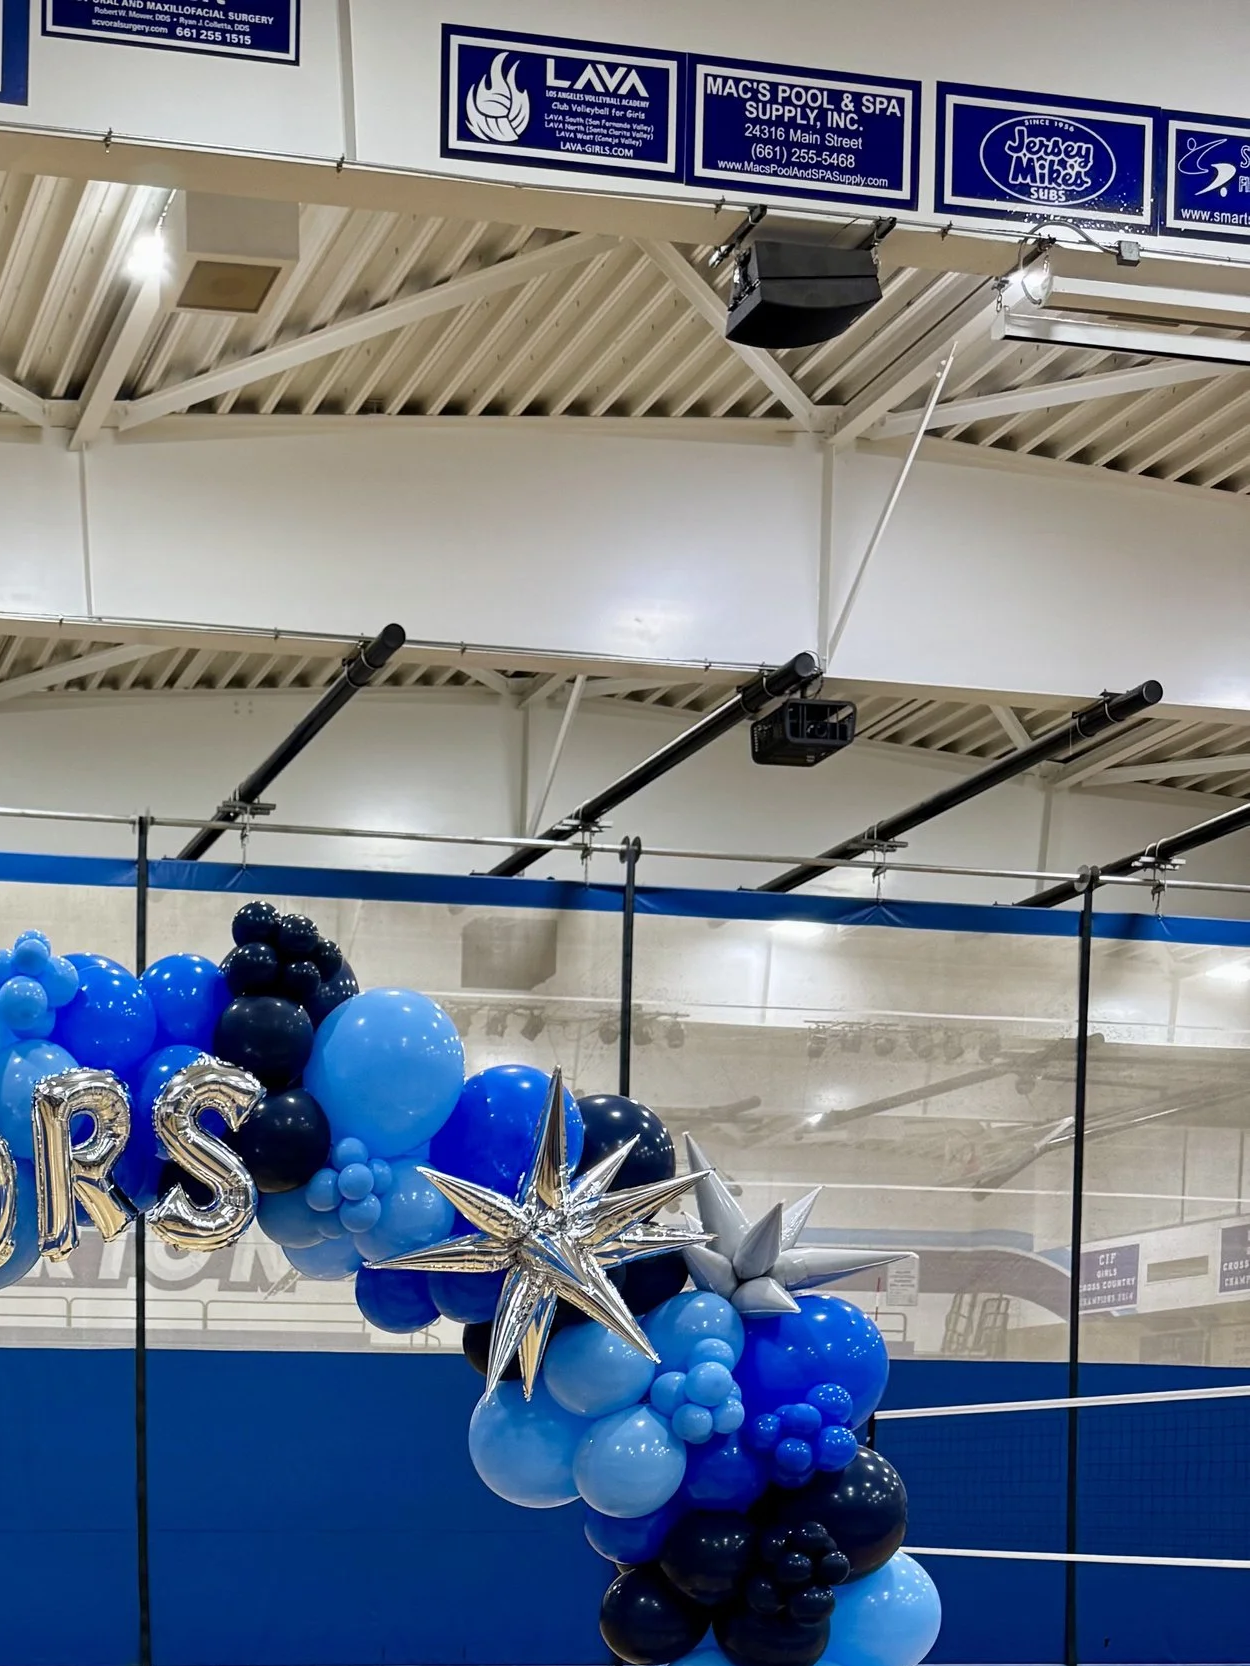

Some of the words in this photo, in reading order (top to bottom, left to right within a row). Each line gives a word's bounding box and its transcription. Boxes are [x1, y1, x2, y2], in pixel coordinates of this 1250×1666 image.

[94, 6, 118, 16] Robert
[155, 14, 171, 23] DDS
[179, 16, 197, 26] Ryan
[234, 24, 250, 32] DDS
[121, 0, 144, 9] AND
[146, 1, 225, 19] MAXILLOFACIAL
[228, 12, 274, 25] SURGERY
[91, 18, 168, 34] scvoralsurgery.com
[176, 27, 197, 38] 661
[199, 30, 222, 41] 255
[225, 33, 251, 45] 1515
[546, 58, 649, 98] LAVA
[546, 90, 557, 98] LOS
[558, 91, 584, 101] ANGELES
[584, 94, 620, 105] VOLLEYBALL
[621, 98, 650, 108] ACADEMY
[706, 75, 771, 101] MAC'S
[777, 85, 834, 110] POOL
[841, 93, 855, 112] &
[861, 95, 901, 117] SPA
[552, 101, 569, 111] Club
[571, 103, 609, 116] Volleyball
[612, 108, 625, 117] for
[626, 109, 645, 120] Girls
[745, 101, 821, 129] SUPPLY,
[827, 110, 864, 131] INC.
[544, 113, 563, 122] LAVA
[565, 115, 584, 124] South
[632, 123, 654, 133] Valley)
[544, 121, 563, 130] LAVA
[565, 123, 584, 132] North
[631, 130, 654, 140] Valley)
[1054, 121, 1075, 132] 1956
[556, 130, 575, 139] LAVA
[576, 132, 594, 141] West
[620, 136, 643, 147] Valley)
[744, 123, 785, 141] 24316
[789, 128, 821, 145] Main
[825, 132, 863, 150] Street
[560, 141, 634, 157] LAVA-GIRLS.COM
[751, 143, 787, 164] (661)
[791, 148, 856, 168] 255-5468
[1005, 126, 1093, 172] Jersey
[717, 159, 889, 187] www.MacsPoolAndSPASupply.com
[1009, 155, 1092, 191] Mike's
[1030, 187, 1066, 201] SUBS
[1099, 1252, 1117, 1266] CIF
[1222, 1260, 1250, 1271] CROSS
[1096, 1268, 1117, 1278] GIRLS
[1102, 1276, 1136, 1289] COUNTRY
